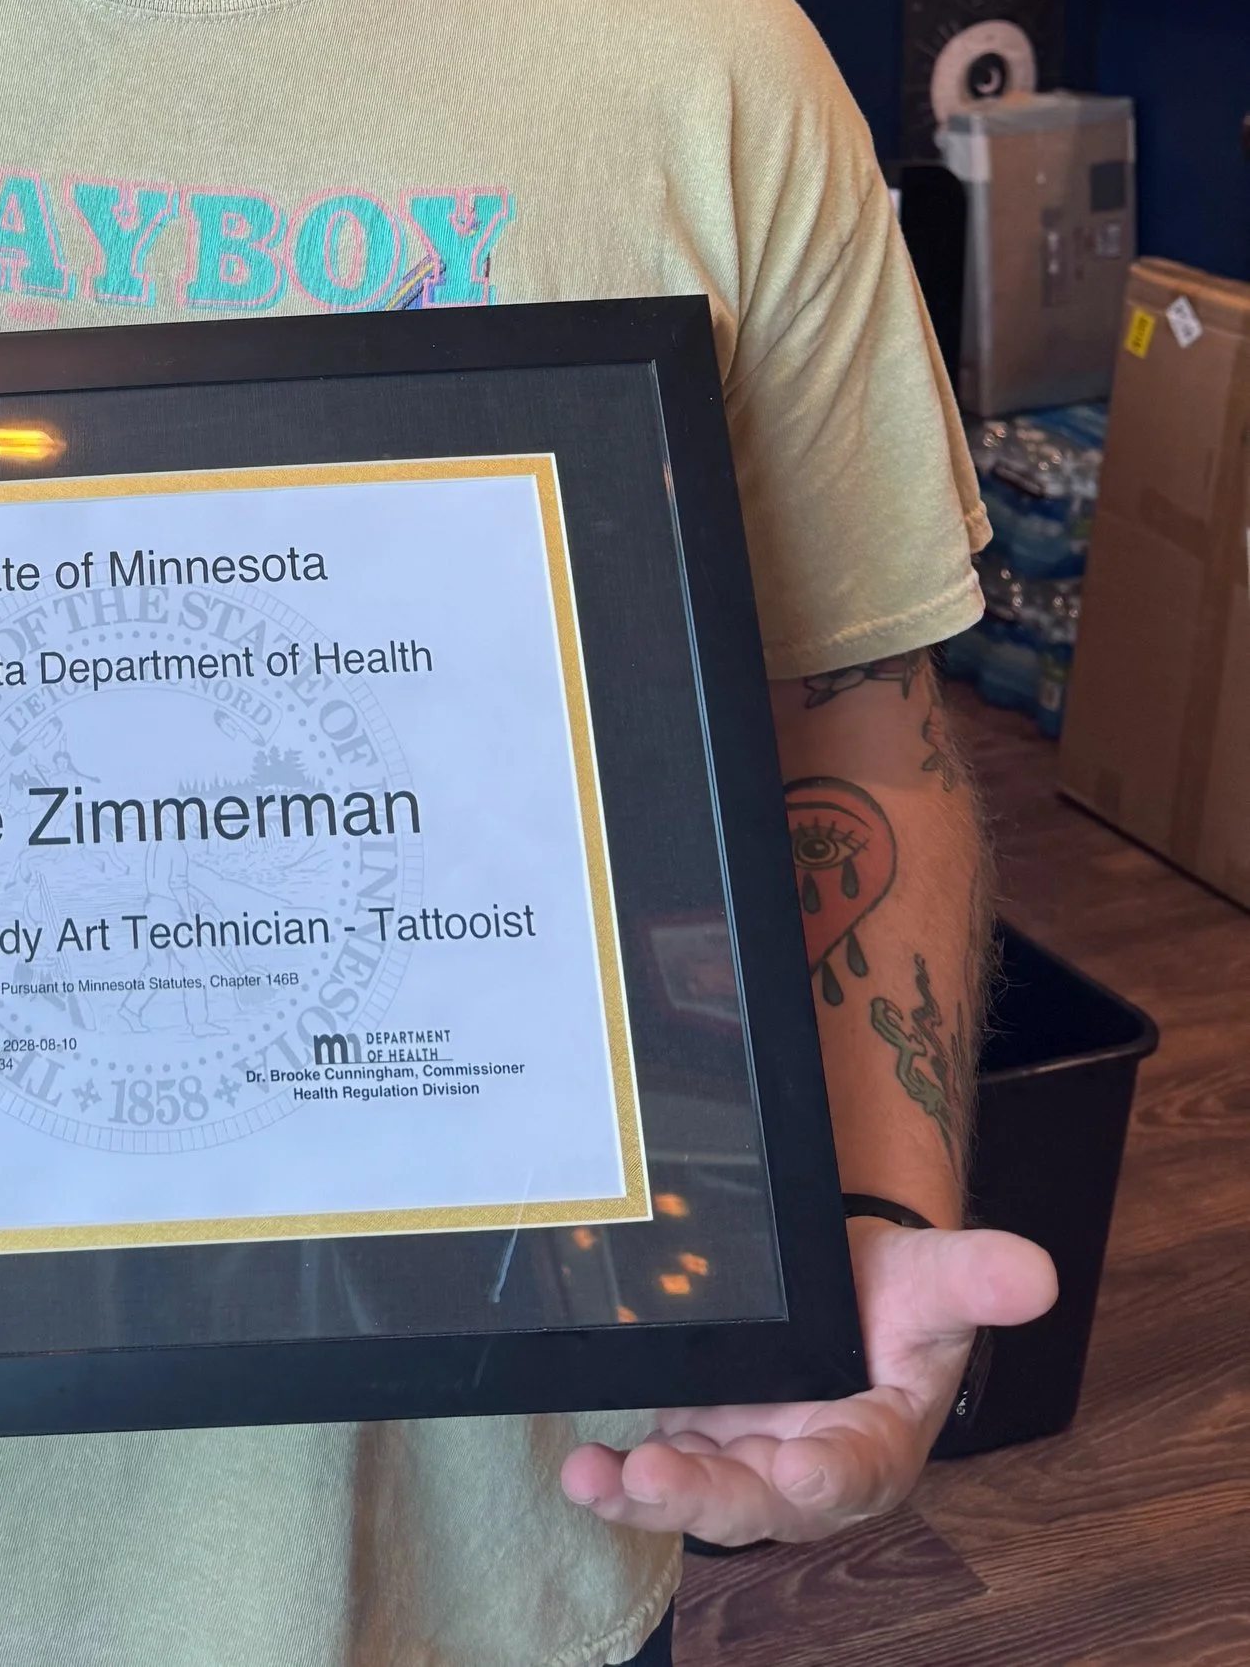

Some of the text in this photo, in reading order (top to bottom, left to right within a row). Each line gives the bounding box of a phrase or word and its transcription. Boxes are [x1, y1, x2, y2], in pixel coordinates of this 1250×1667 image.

[55, 551, 94, 590] of
[109, 546, 329, 588] Minnesota
[40, 646, 255, 692] Department
[266, 642, 301, 677] of
[314, 639, 434, 676] Health
[52, 585, 171, 635] THE
[318, 699, 379, 767] OF
[28, 786, 421, 846] Zimmerman
[56, 917, 111, 953] Art
[121, 910, 330, 950] Technician
[367, 903, 537, 942] Tattooist
[1, 972, 299, 995] Pursuant to Minnesota Statutes, Chapter 146B
[2, 1037, 77, 1053] 2028-08-10
[366, 1030, 451, 1045] DEPARTMENT
[368, 1047, 438, 1063] OF HEALTH
[246, 1061, 526, 1083] Dr. Brooke Cunningham, Commissioner
[106, 1076, 209, 1125] 1858
[293, 1082, 480, 1102] Health Regulation Division
